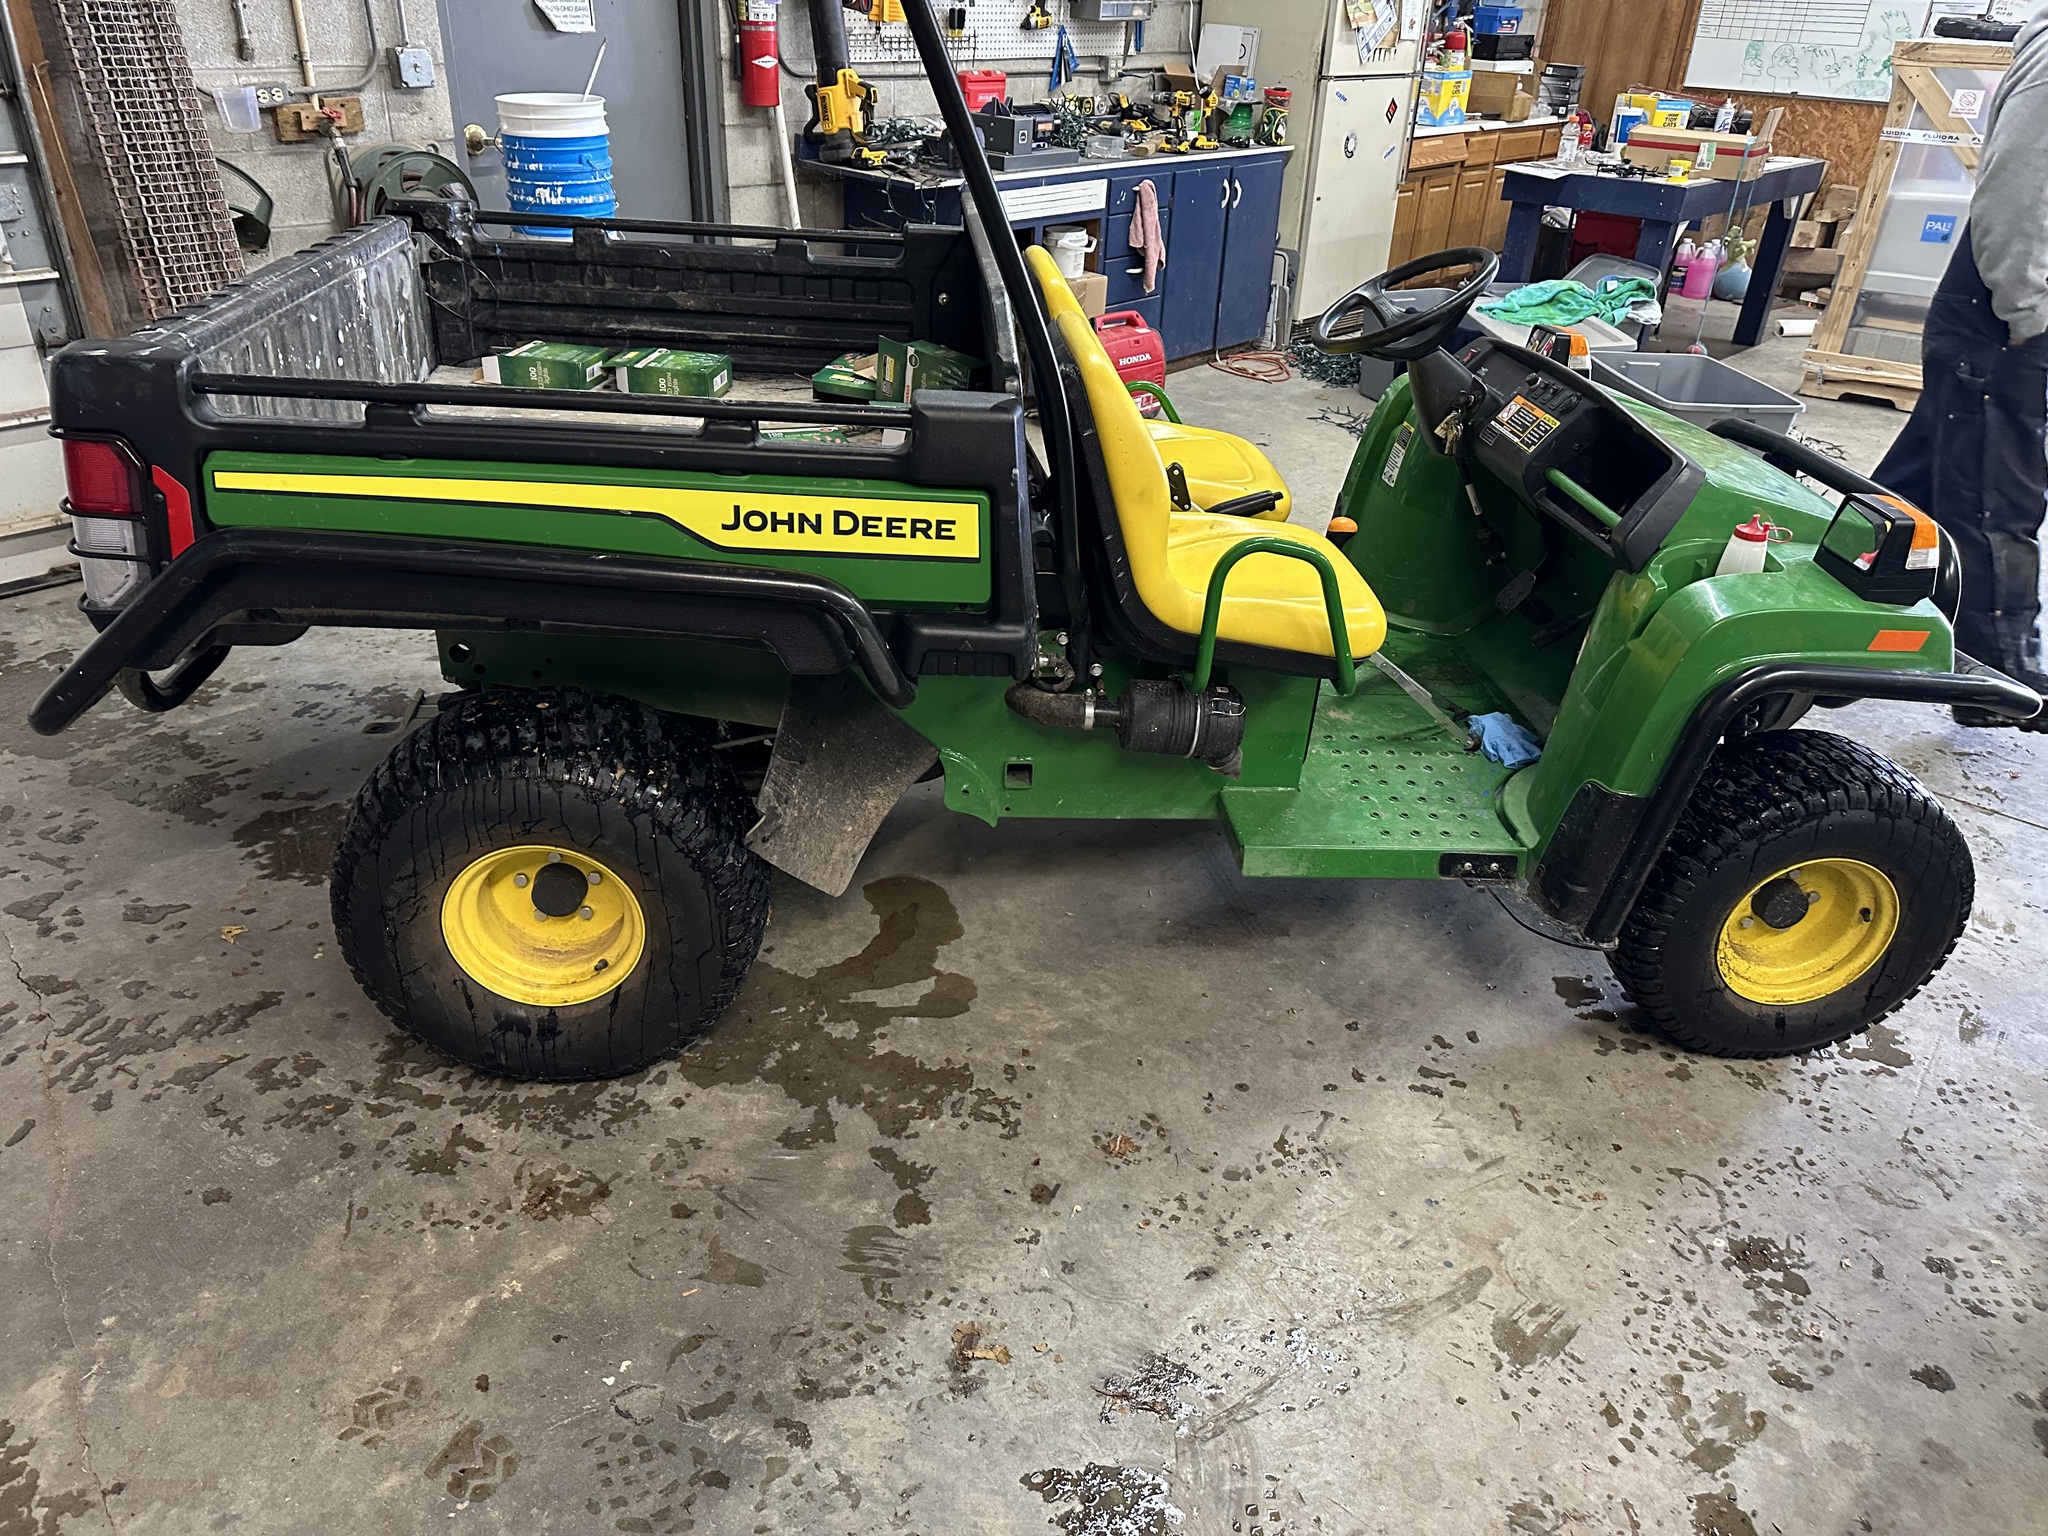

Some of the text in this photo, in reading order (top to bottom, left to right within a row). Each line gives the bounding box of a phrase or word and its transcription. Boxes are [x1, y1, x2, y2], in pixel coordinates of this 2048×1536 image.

[1922, 132, 1960, 141] FLUIDRA
[1925, 221, 1950, 232] PAL
[1118, 353, 1152, 366] HONDA
[528, 366, 538, 381] 100
[658, 377, 667, 393] 100
[721, 504, 957, 541] JOHN DEERE
